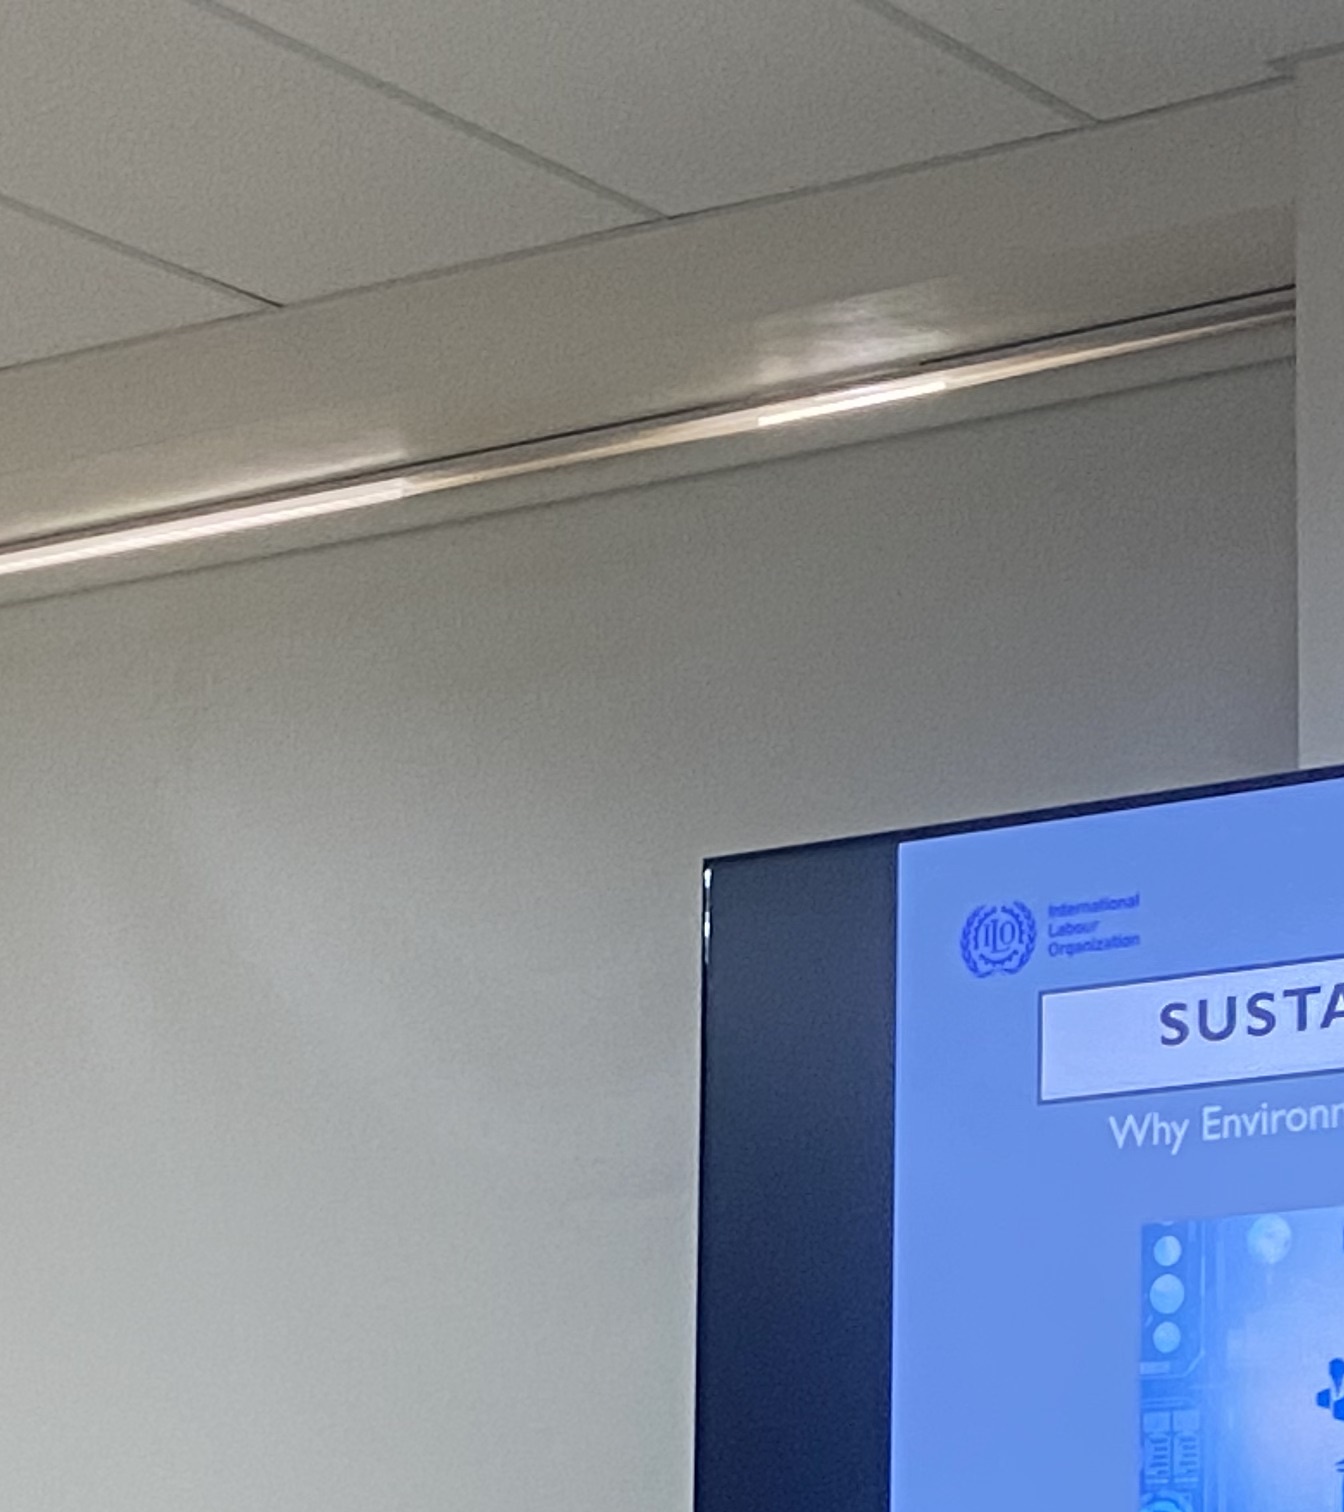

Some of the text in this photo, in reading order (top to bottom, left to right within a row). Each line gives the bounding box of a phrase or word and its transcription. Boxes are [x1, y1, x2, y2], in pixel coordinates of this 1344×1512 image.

[1048, 891, 1141, 918] International
[1048, 920, 1101, 938] Labour
[1048, 933, 1141, 958] Organization
[1108, 1111, 1190, 1156] Why
